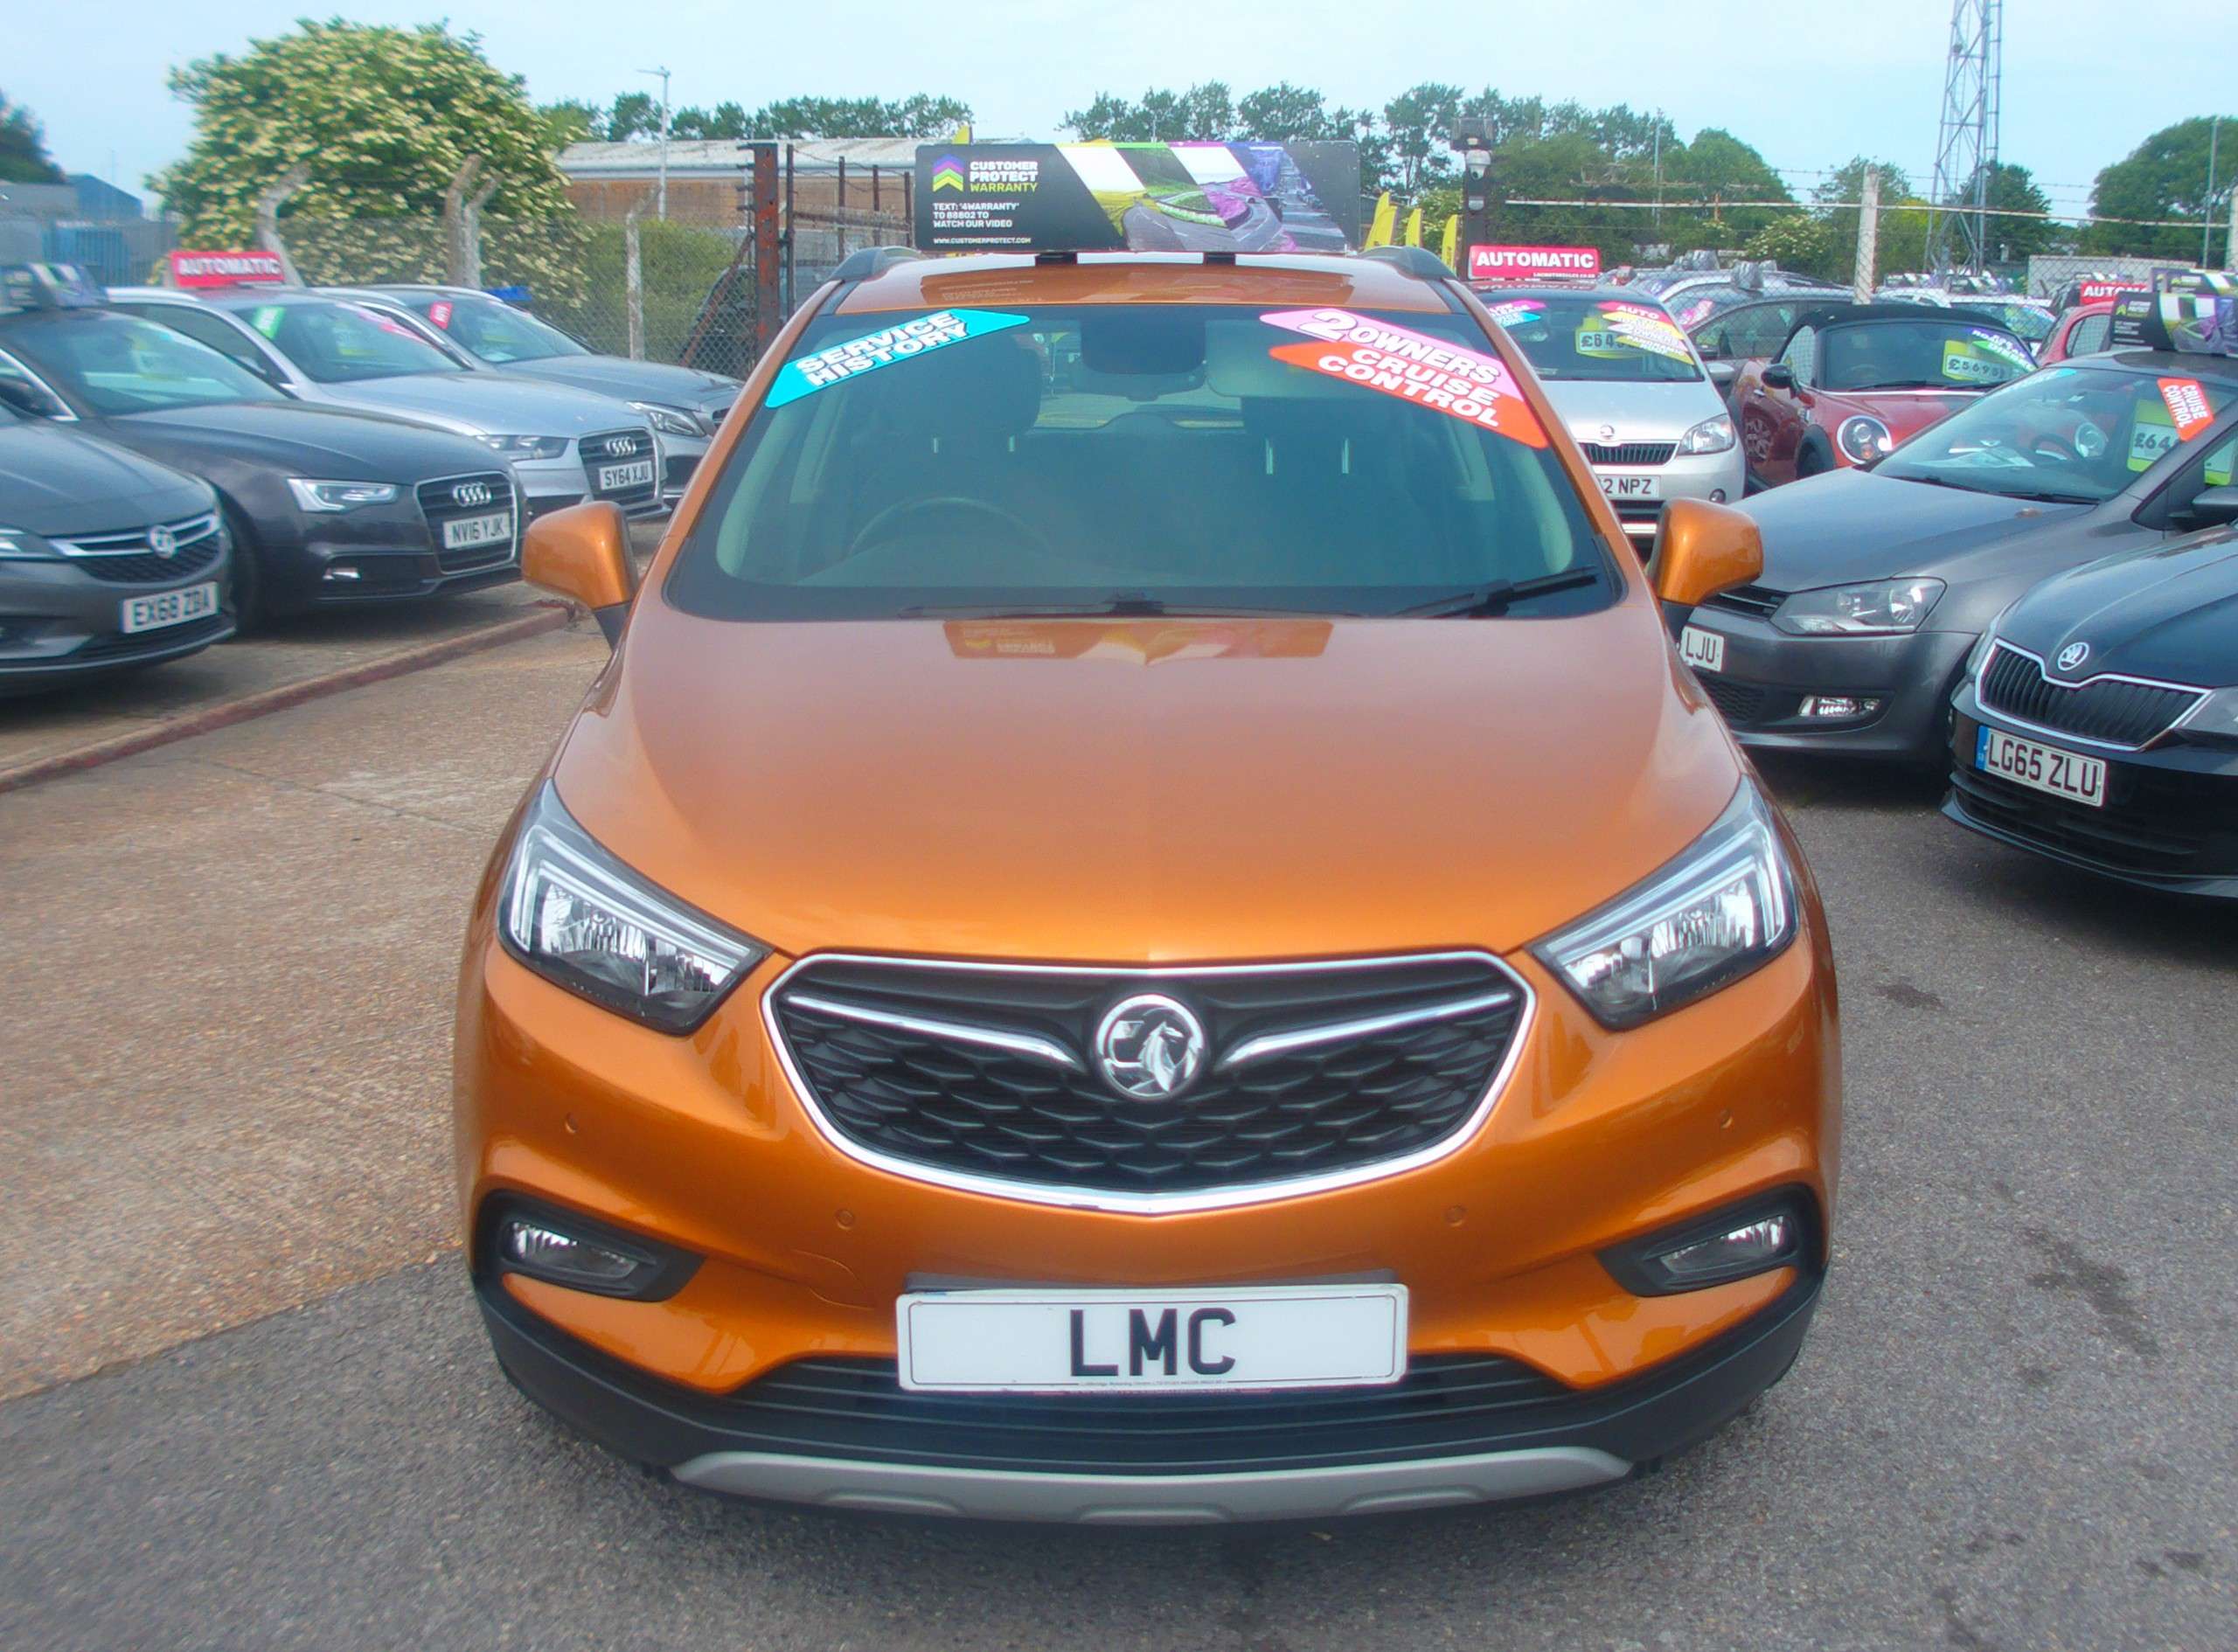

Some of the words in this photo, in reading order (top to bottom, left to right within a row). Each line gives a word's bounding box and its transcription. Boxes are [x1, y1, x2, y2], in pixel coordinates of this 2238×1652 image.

[970, 161, 1038, 170] CUSTOMER
[970, 170, 1038, 182] PROTECT
[970, 183, 1038, 192] WARRANTY
[177, 257, 281, 276] AUTOMATIC
[1476, 251, 1595, 268] AUTOMATIC
[1616, 305, 1659, 320] AUTO
[796, 313, 958, 373] SERVICE
[804, 323, 968, 386] HISTORY
[1298, 310, 1357, 340] 2
[1348, 324, 1500, 385] OWNERS
[1317, 355, 1499, 427] CONTROL
[1352, 349, 1501, 406] CRUISE
[2164, 385, 2193, 428] CONTROL
[2182, 385, 2208, 420] CRUISE
[605, 468, 631, 487] SY64
[1618, 478, 1651, 495] NPZ
[452, 521, 481, 543] NV16
[483, 517, 504, 539] YJK
[132, 595, 179, 627] EX68
[1685, 631, 1717, 663] LJU
[1988, 733, 2043, 781] LG65
[2048, 753, 2098, 797] ZLU
[1070, 1307, 1236, 1378] LMC
